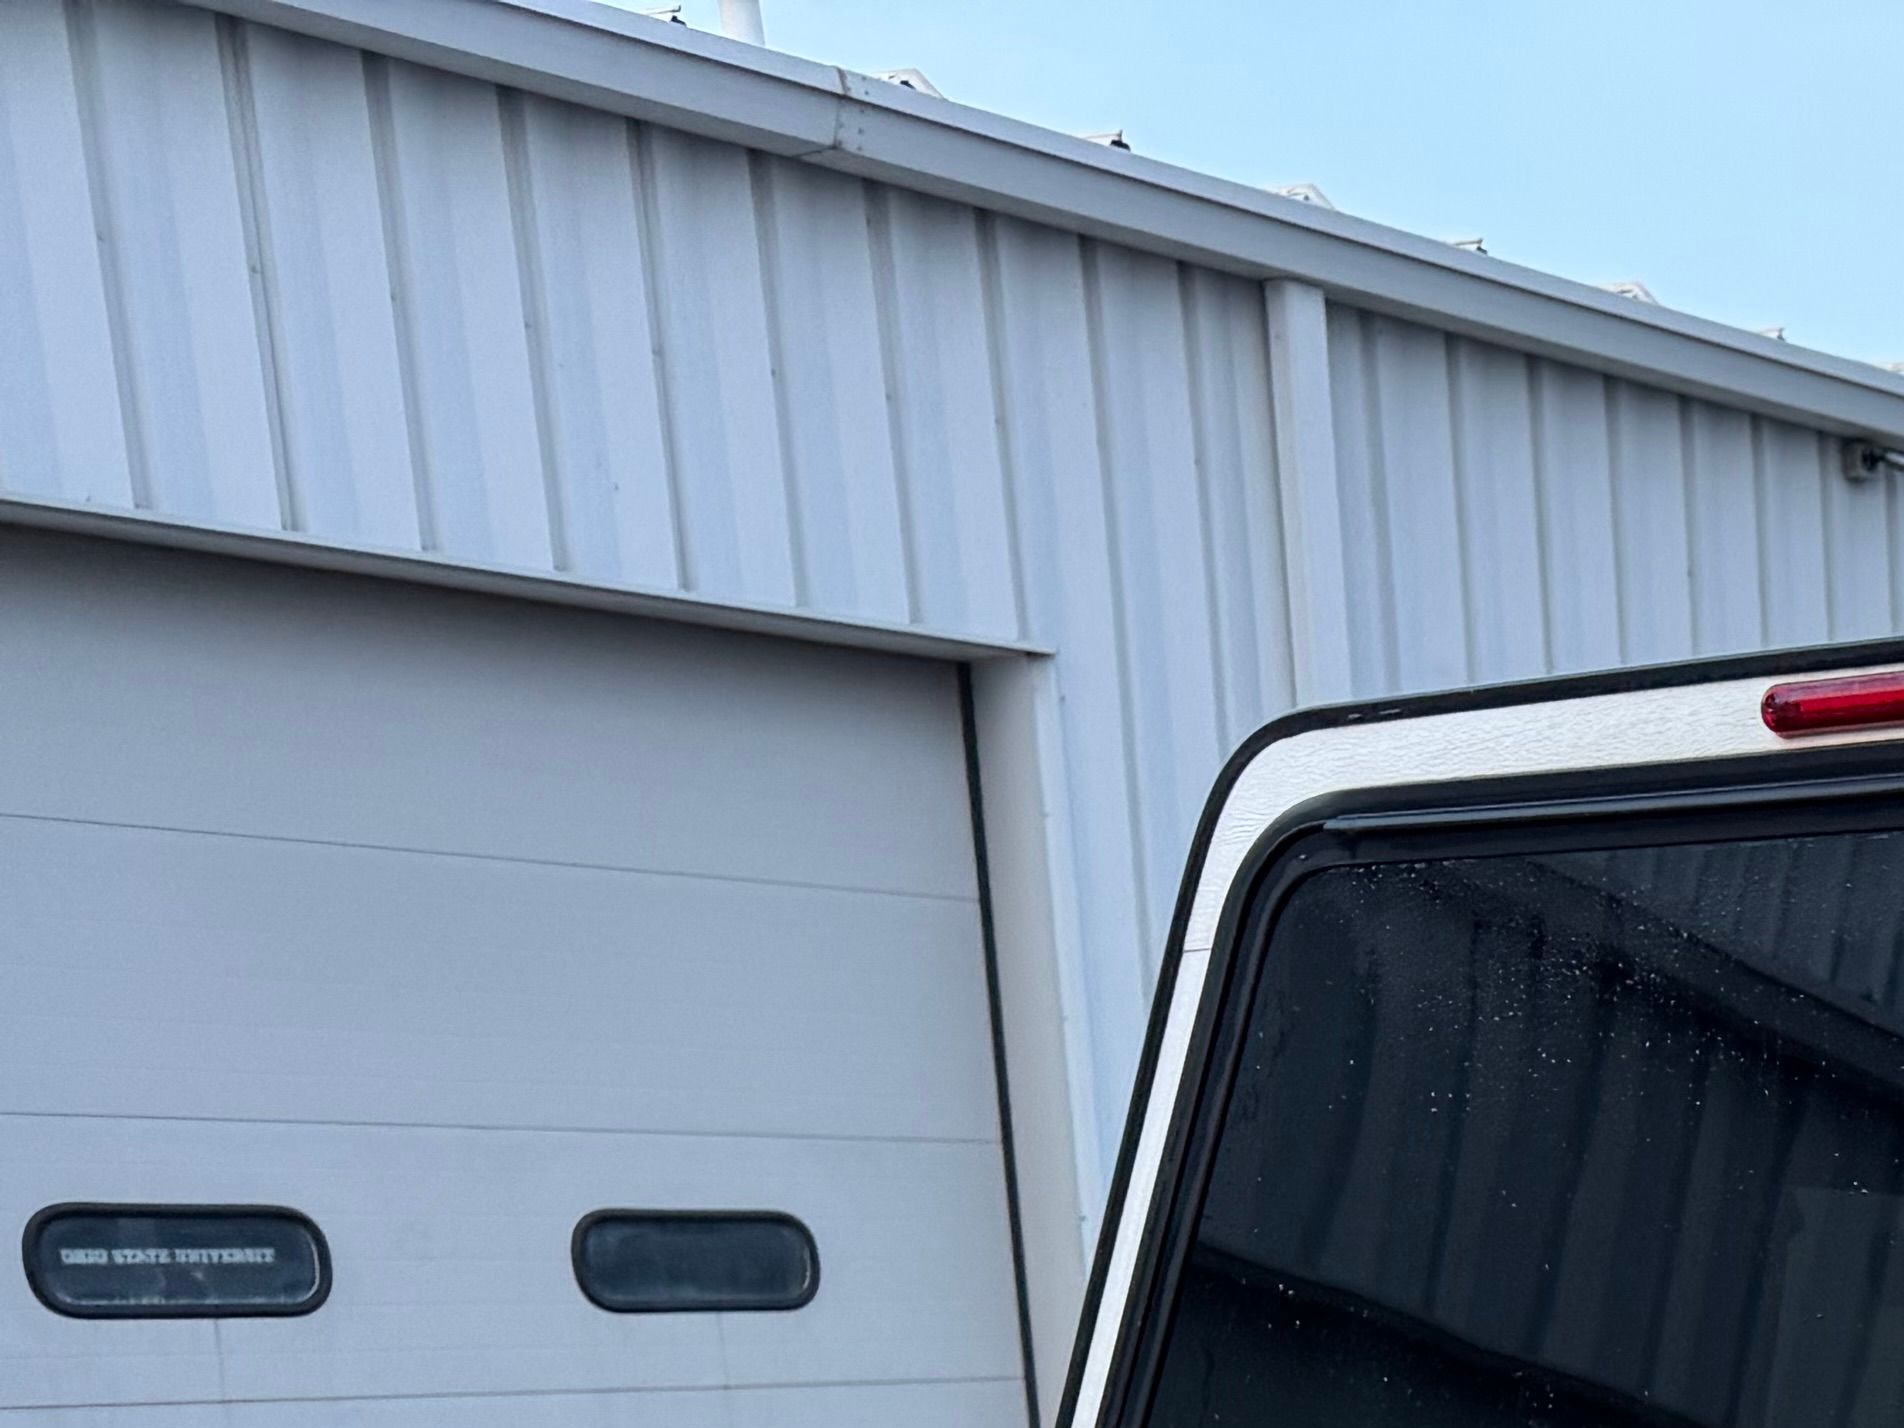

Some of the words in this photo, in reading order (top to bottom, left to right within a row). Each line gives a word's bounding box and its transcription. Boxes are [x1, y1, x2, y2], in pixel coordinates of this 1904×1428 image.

[60, 1248, 108, 1264] OHIO
[111, 1248, 171, 1264] STATE
[174, 1248, 275, 1264] UNIVERSITY
